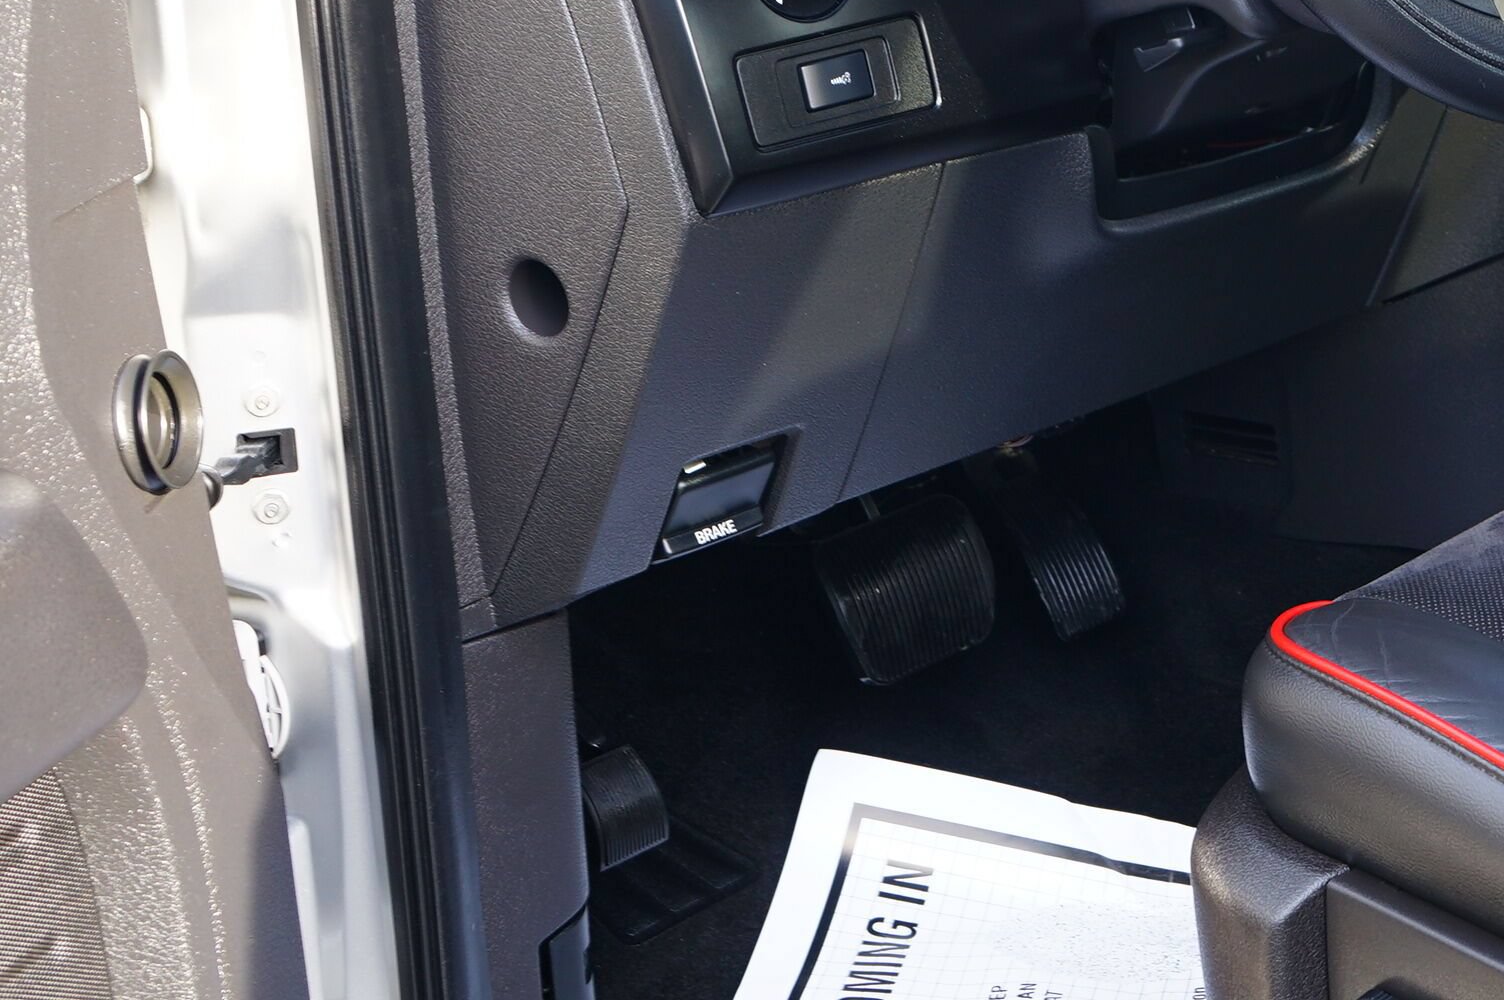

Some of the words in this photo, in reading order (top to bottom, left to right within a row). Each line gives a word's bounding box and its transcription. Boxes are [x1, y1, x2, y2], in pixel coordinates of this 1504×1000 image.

[694, 519, 738, 545] BRAKE
[837, 917, 919, 1000] MING
[878, 859, 934, 906] IN
